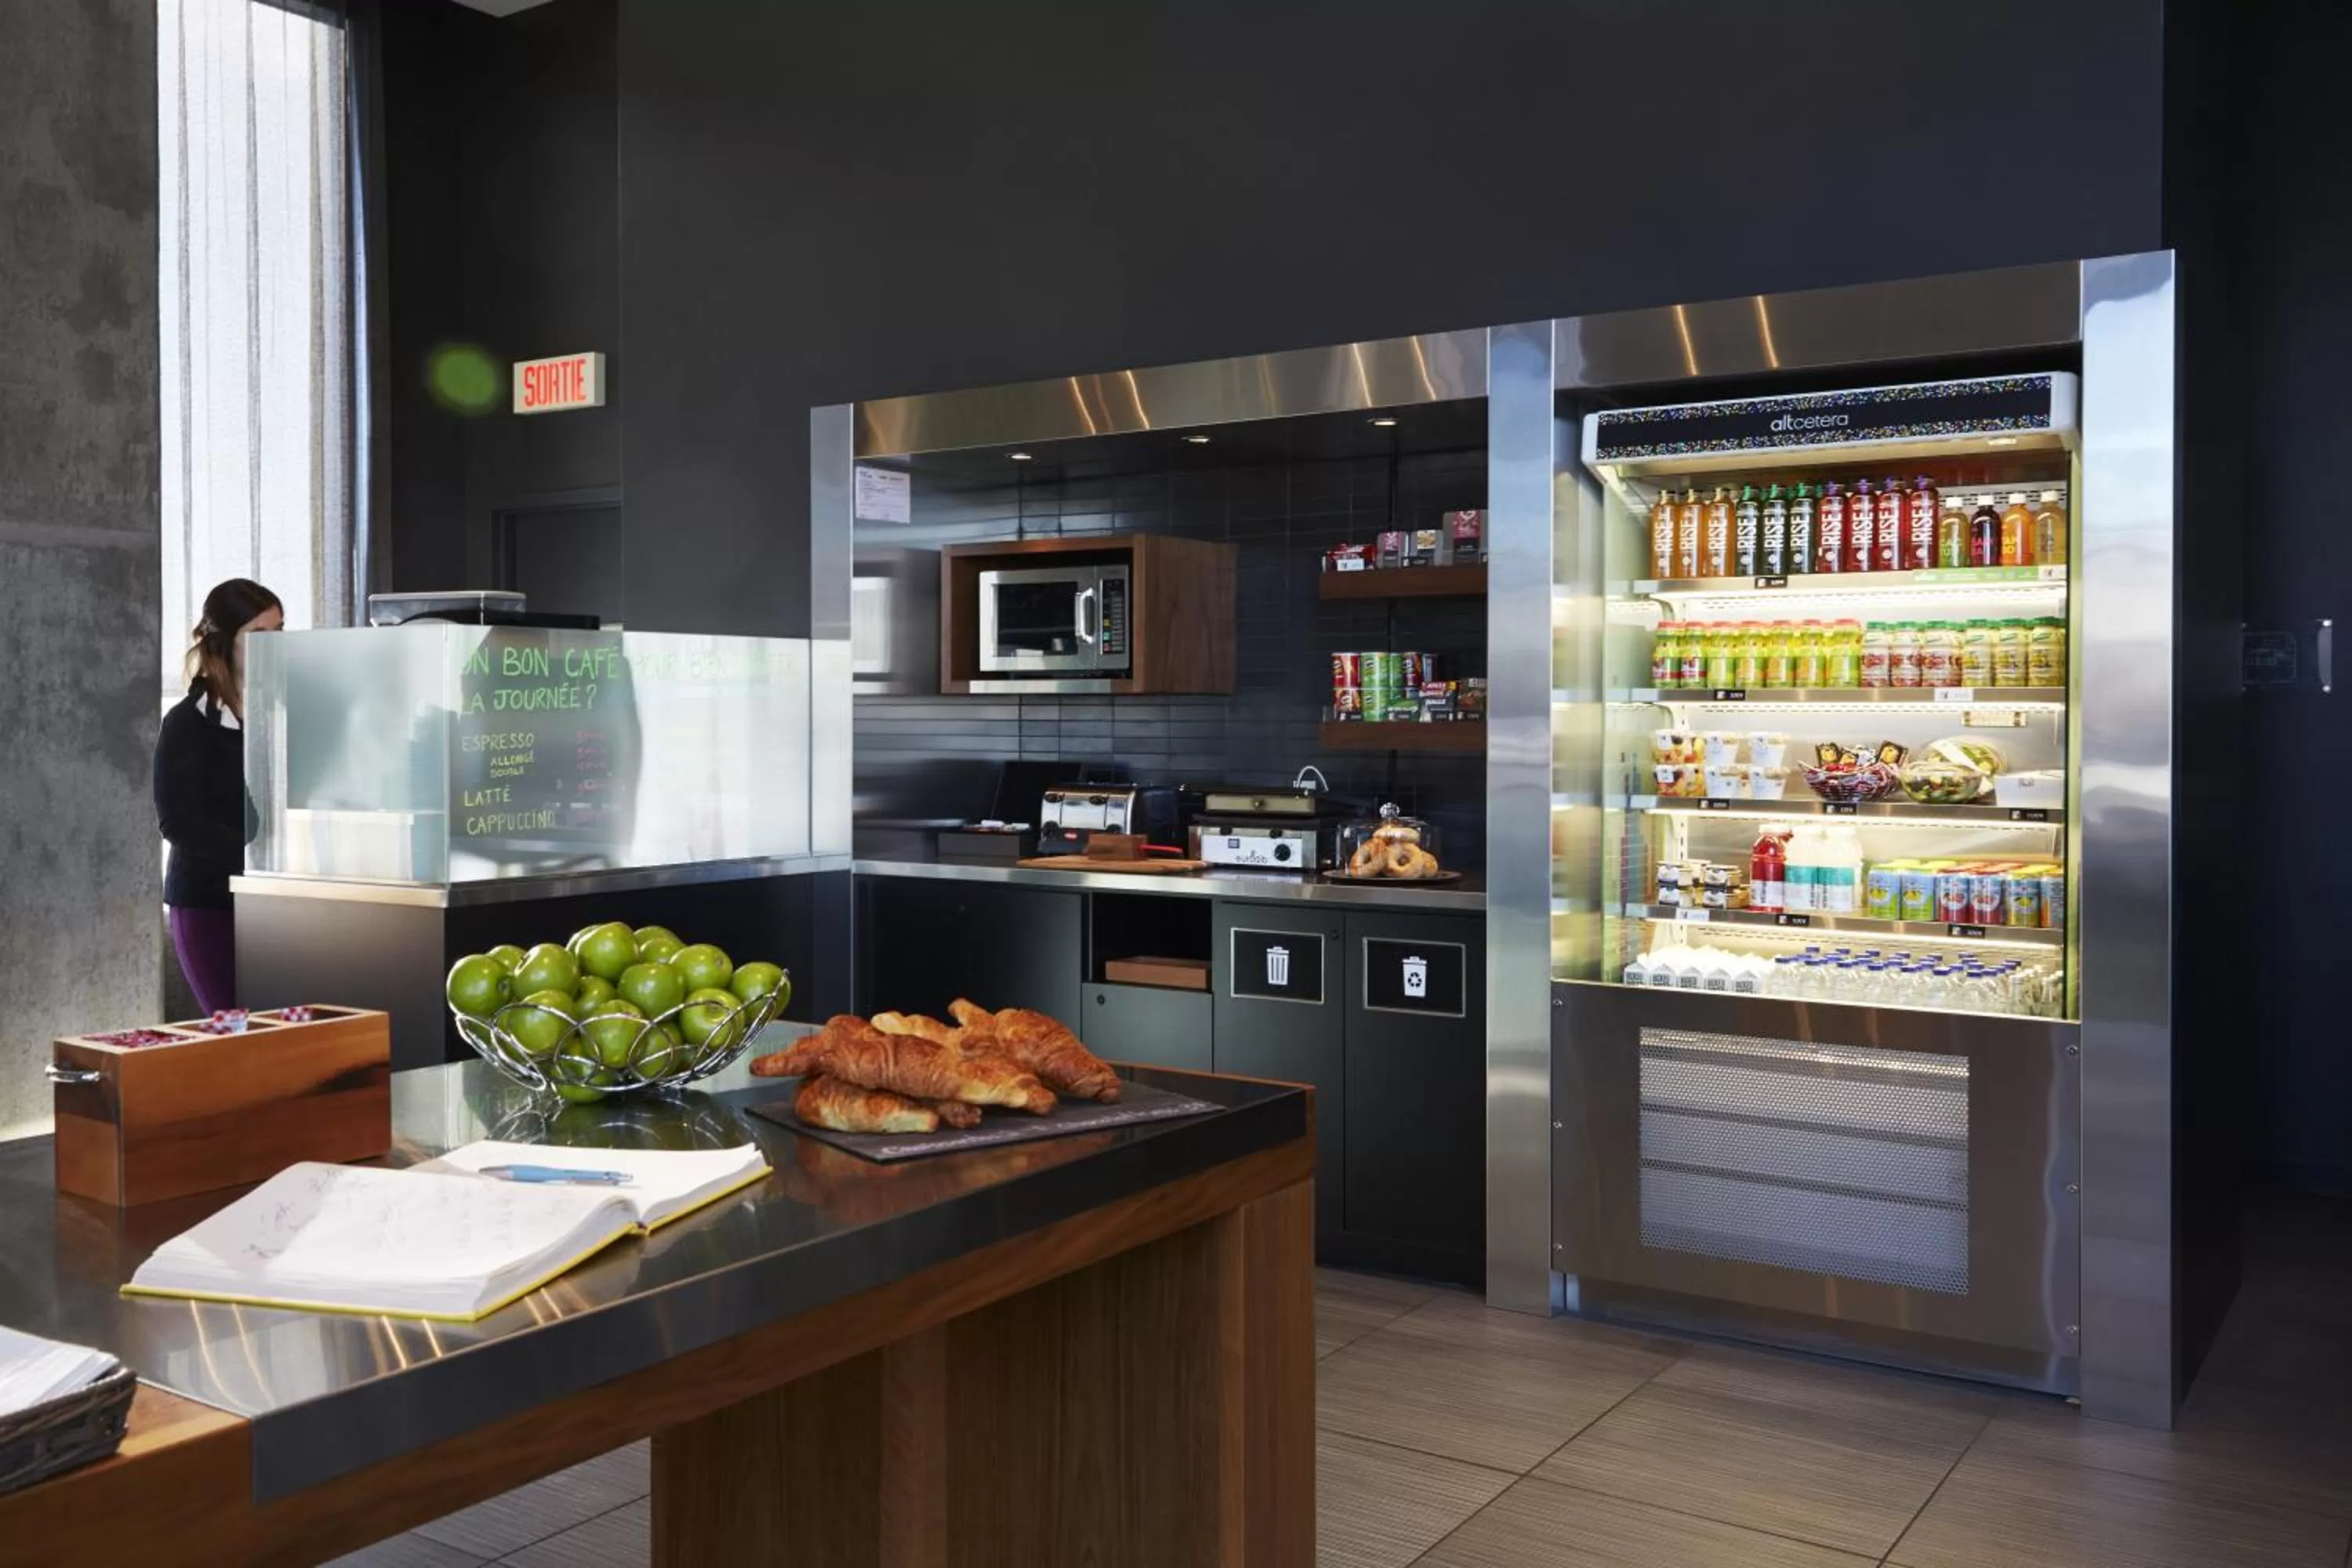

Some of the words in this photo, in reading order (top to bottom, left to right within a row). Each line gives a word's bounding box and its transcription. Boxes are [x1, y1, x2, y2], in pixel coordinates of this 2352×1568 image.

[524, 358, 586, 407] SORTIE
[1770, 414, 1849, 431] altcetera
[1655, 521, 1674, 551] RISE
[1708, 518, 1727, 550] RISE
[1737, 517, 1756, 549] RISE
[1765, 517, 1784, 548] RISE
[1791, 514, 1809, 547] RISE
[1822, 513, 1841, 545] RISE
[1853, 512, 1873, 544] RISE
[1879, 510, 1899, 542] RISE
[1911, 509, 1933, 542] RISE
[502, 647, 549, 677] BON
[564, 646, 619, 680] CAFÉ
[461, 732, 535, 753] ESPRESSO
[466, 809, 558, 836] CAPPUCCINO
